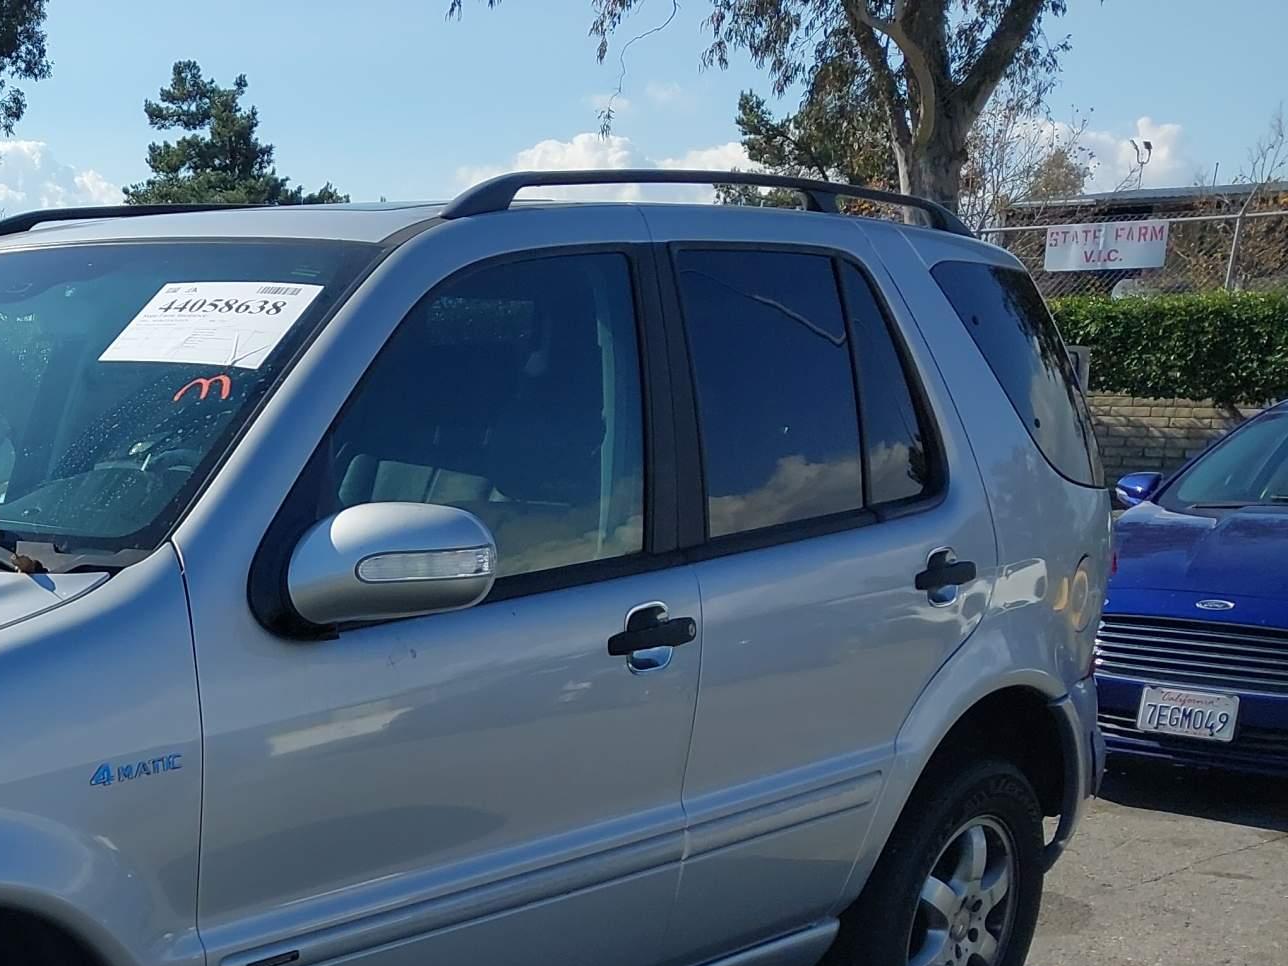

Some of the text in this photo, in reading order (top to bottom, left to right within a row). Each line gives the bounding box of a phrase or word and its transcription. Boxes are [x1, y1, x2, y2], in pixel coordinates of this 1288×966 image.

[1049, 225, 1165, 248] STATE FARM
[158, 298, 288, 316] 44058638
[1146, 703, 1230, 734] 7EGM049
